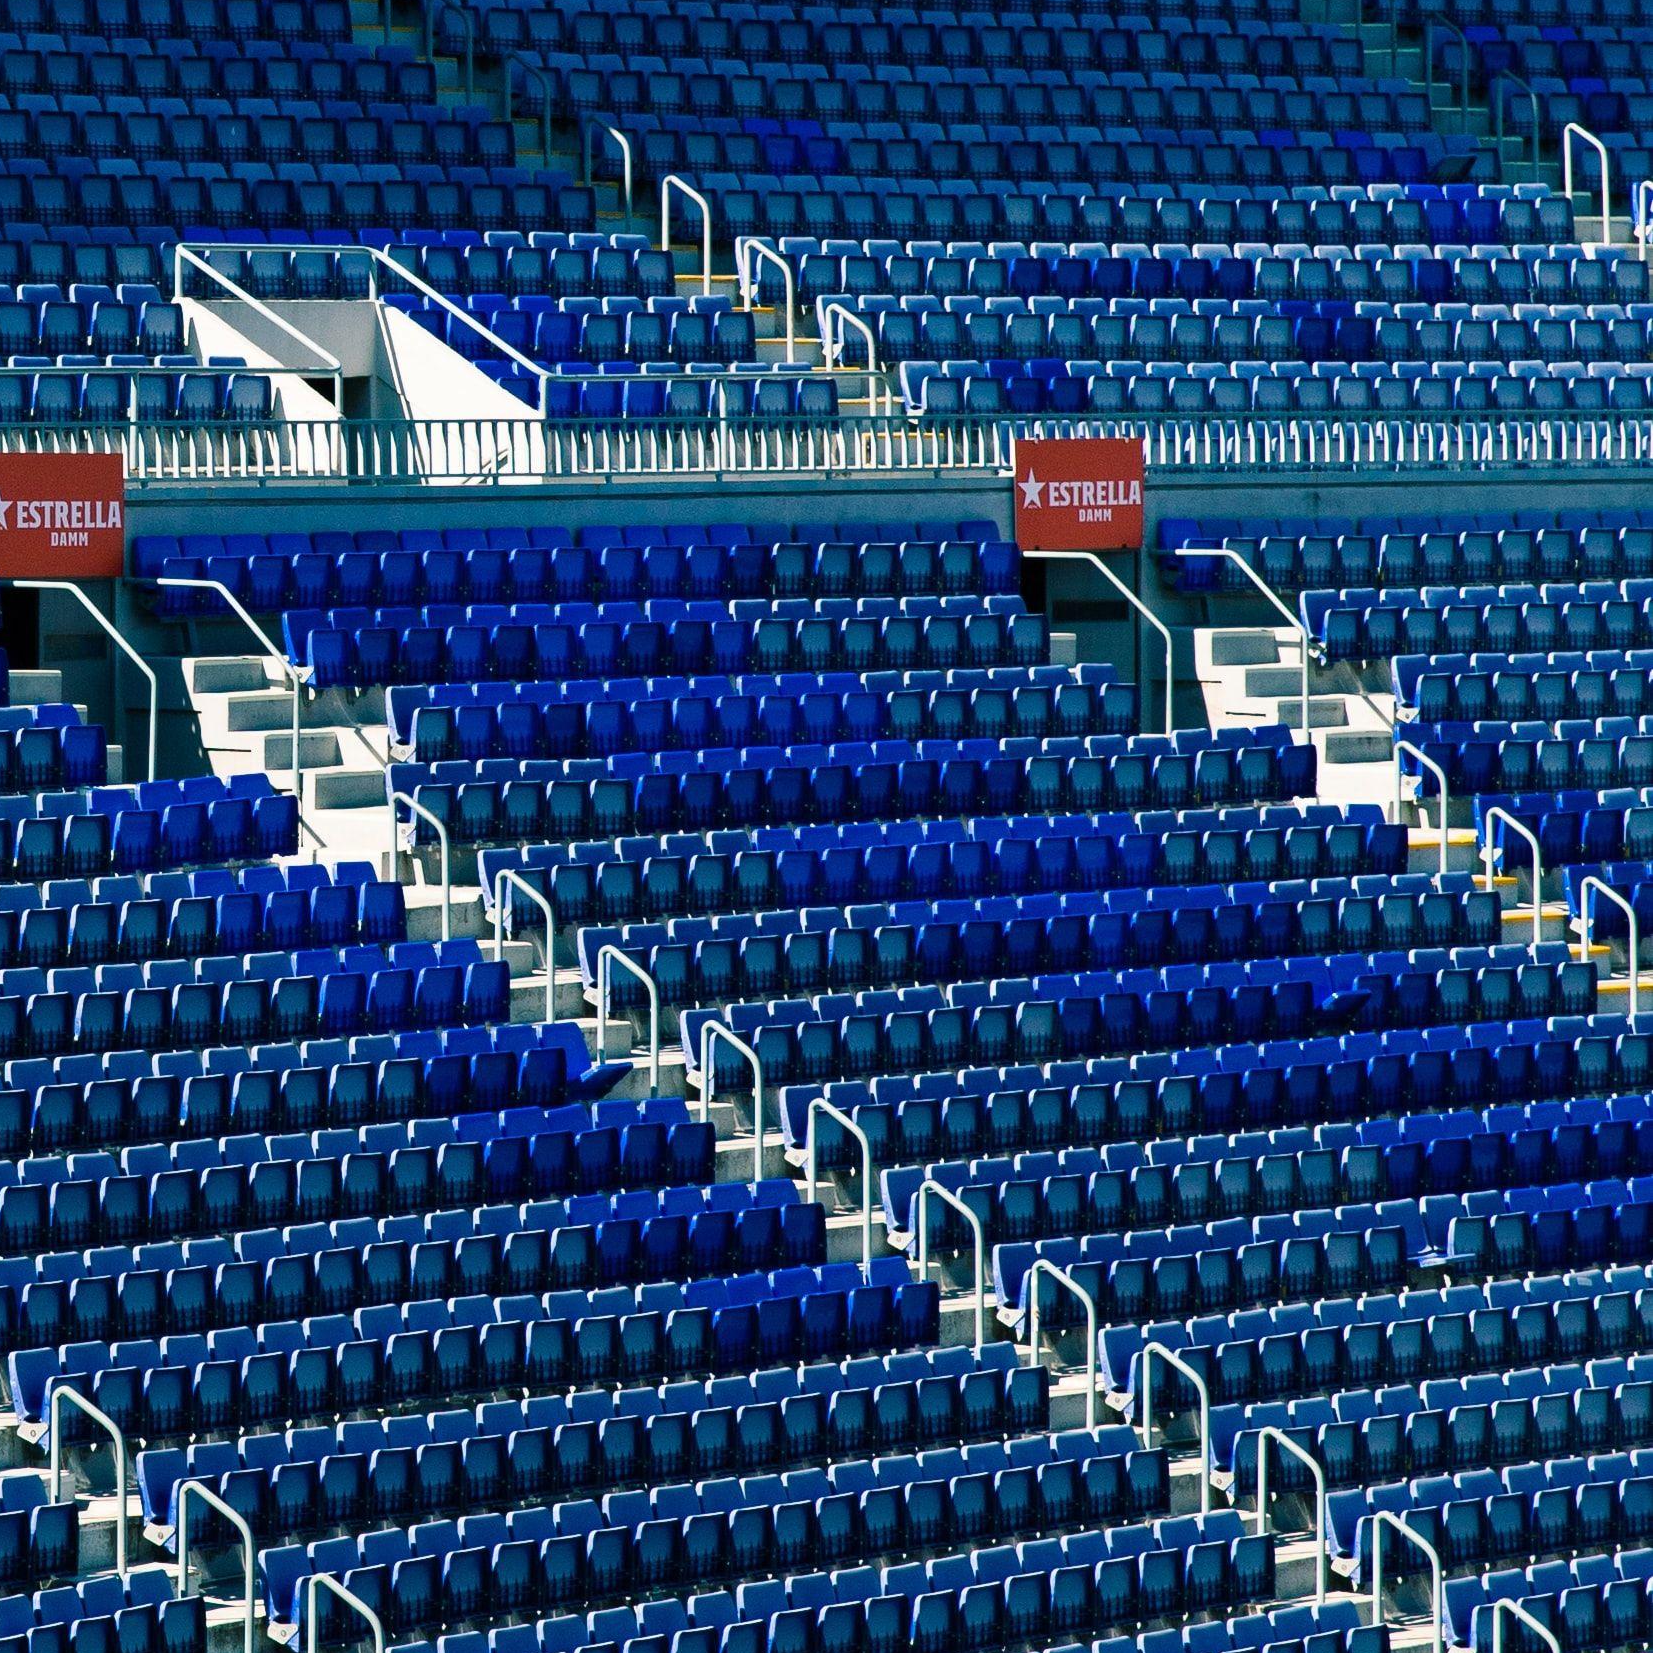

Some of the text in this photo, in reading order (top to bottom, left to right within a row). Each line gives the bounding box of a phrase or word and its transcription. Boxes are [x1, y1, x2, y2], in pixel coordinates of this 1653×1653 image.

[1049, 480, 1142, 506] ESTRELLA
[16, 500, 122, 529] ESTRELLA
[1078, 508, 1112, 523] DAMM
[50, 532, 89, 547] DAMM
